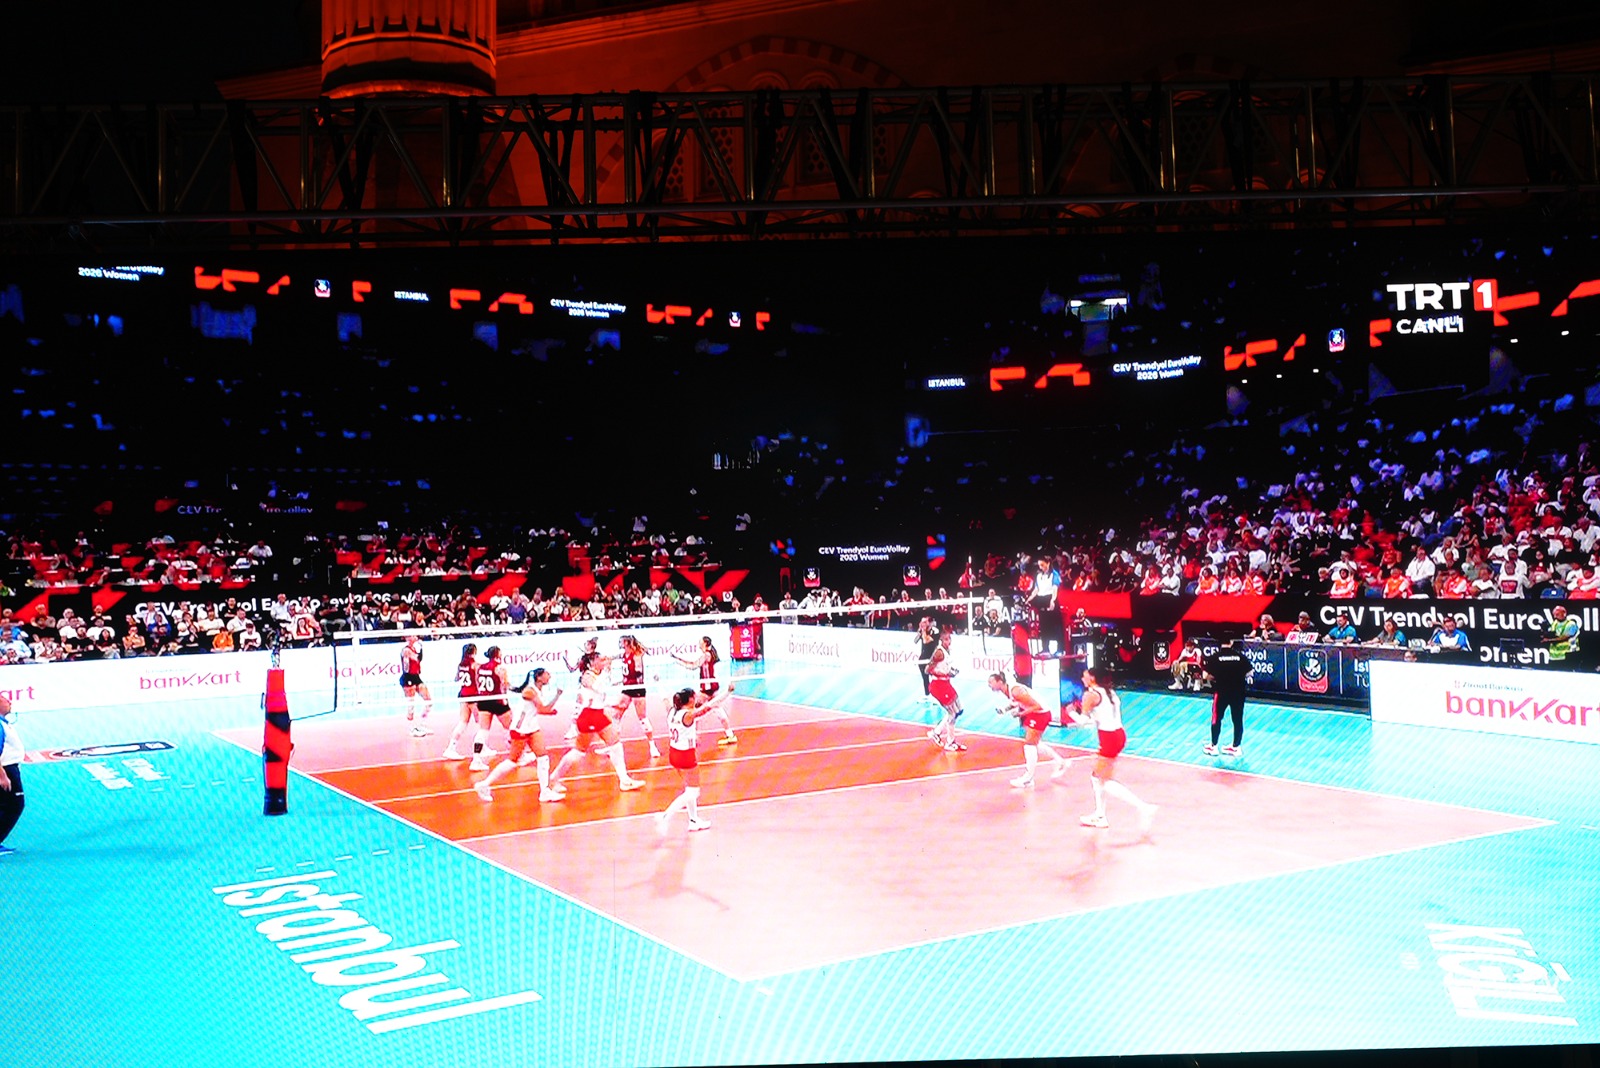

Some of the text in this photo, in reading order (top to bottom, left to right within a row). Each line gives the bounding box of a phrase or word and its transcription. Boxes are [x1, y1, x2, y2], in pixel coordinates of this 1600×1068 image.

[103, 269, 140, 281] Women
[1386, 281, 1493, 311] TRT 1
[1113, 355, 1202, 373] CEV Trendyol EuroVolley
[1137, 368, 1184, 381] 2026 Women
[836, 546, 868, 555] Trendyol
[869, 544, 910, 553] EuroVolley
[859, 553, 889, 561] Women
[1369, 606, 1475, 629] Trendyol
[1484, 606, 1600, 632] EuroVoll
[479, 676, 494, 692] 20
